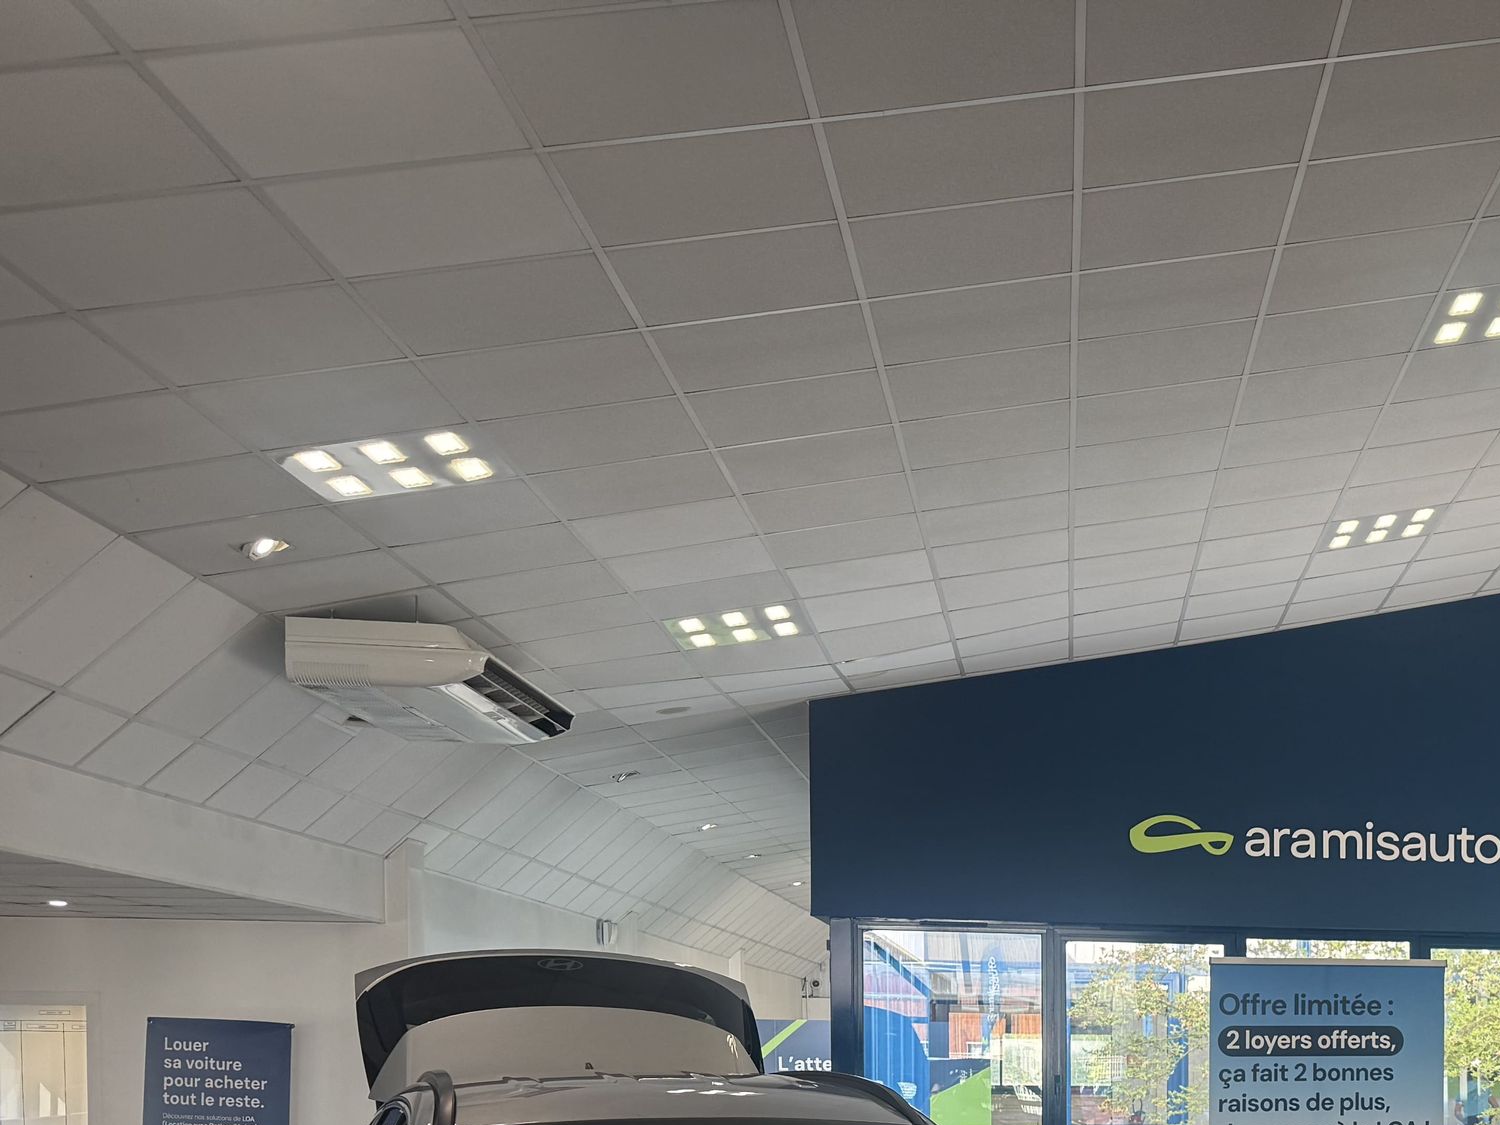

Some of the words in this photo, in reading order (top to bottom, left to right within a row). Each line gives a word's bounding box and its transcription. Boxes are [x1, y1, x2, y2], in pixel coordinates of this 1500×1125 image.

[1218, 993, 1287, 1016] Offre
[1294, 993, 1382, 1016] limitée
[164, 1037, 209, 1052] Louer
[1226, 1031, 1240, 1050] 2
[1245, 1030, 1312, 1055] loyers
[1317, 1030, 1396, 1052] offerts,
[163, 1058, 182, 1070] sa
[185, 1057, 242, 1072] voiture
[163, 1076, 201, 1091] pour
[204, 1075, 268, 1091] acheter
[1218, 1068, 1246, 1089] ça
[1251, 1063, 1289, 1082] fait
[1294, 1064, 1308, 1081] 2
[1312, 1063, 1394, 1082] bonnes
[162, 1091, 197, 1106] tout
[200, 1091, 214, 1107] le
[218, 1093, 265, 1109] reste.
[1218, 1093, 1300, 1113] raisons
[1306, 1092, 1334, 1111] de
[1339, 1092, 1391, 1116] plus,
